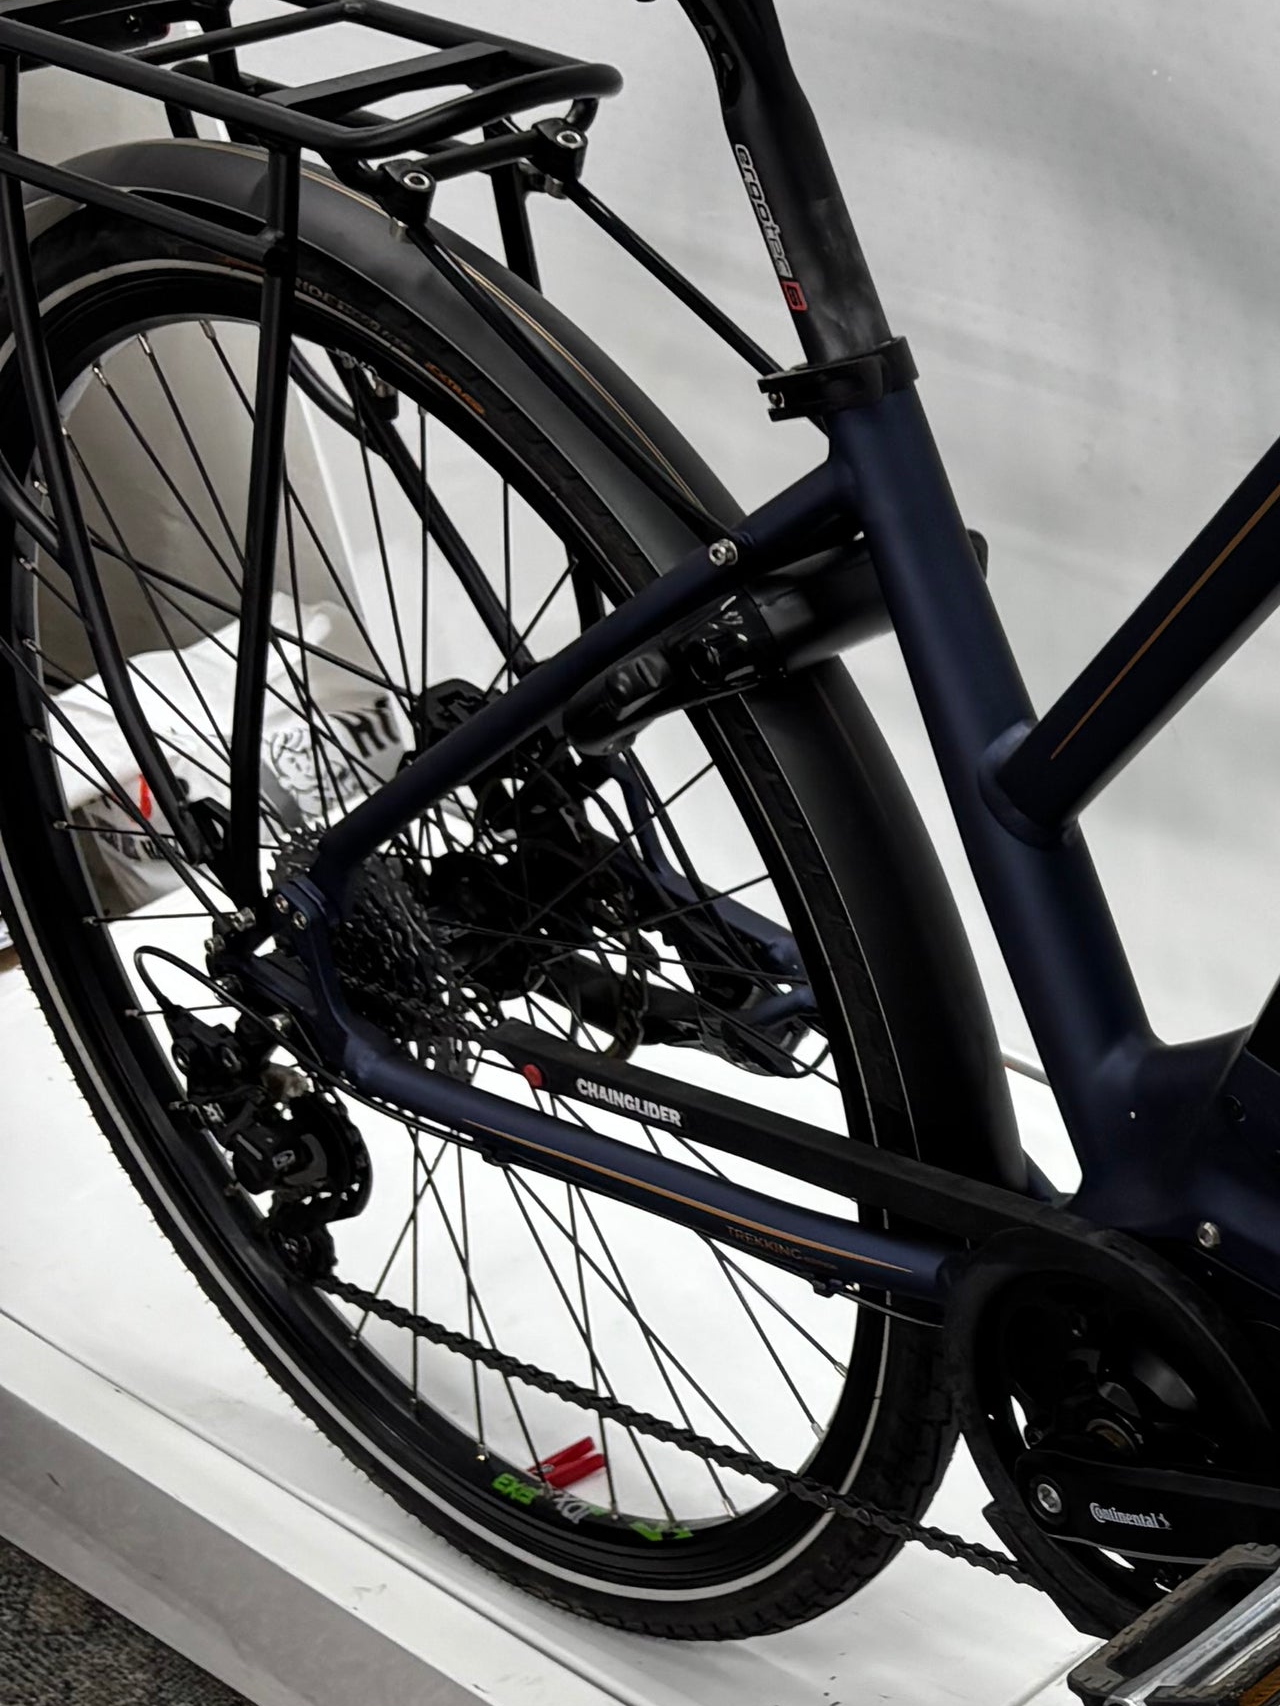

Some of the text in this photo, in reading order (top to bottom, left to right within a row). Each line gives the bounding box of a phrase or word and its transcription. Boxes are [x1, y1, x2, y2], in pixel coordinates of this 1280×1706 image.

[576, 1078, 682, 1127] CHAINGLIDER
[725, 1225, 803, 1260] TREKKING
[1089, 1502, 1160, 1528] Continental
